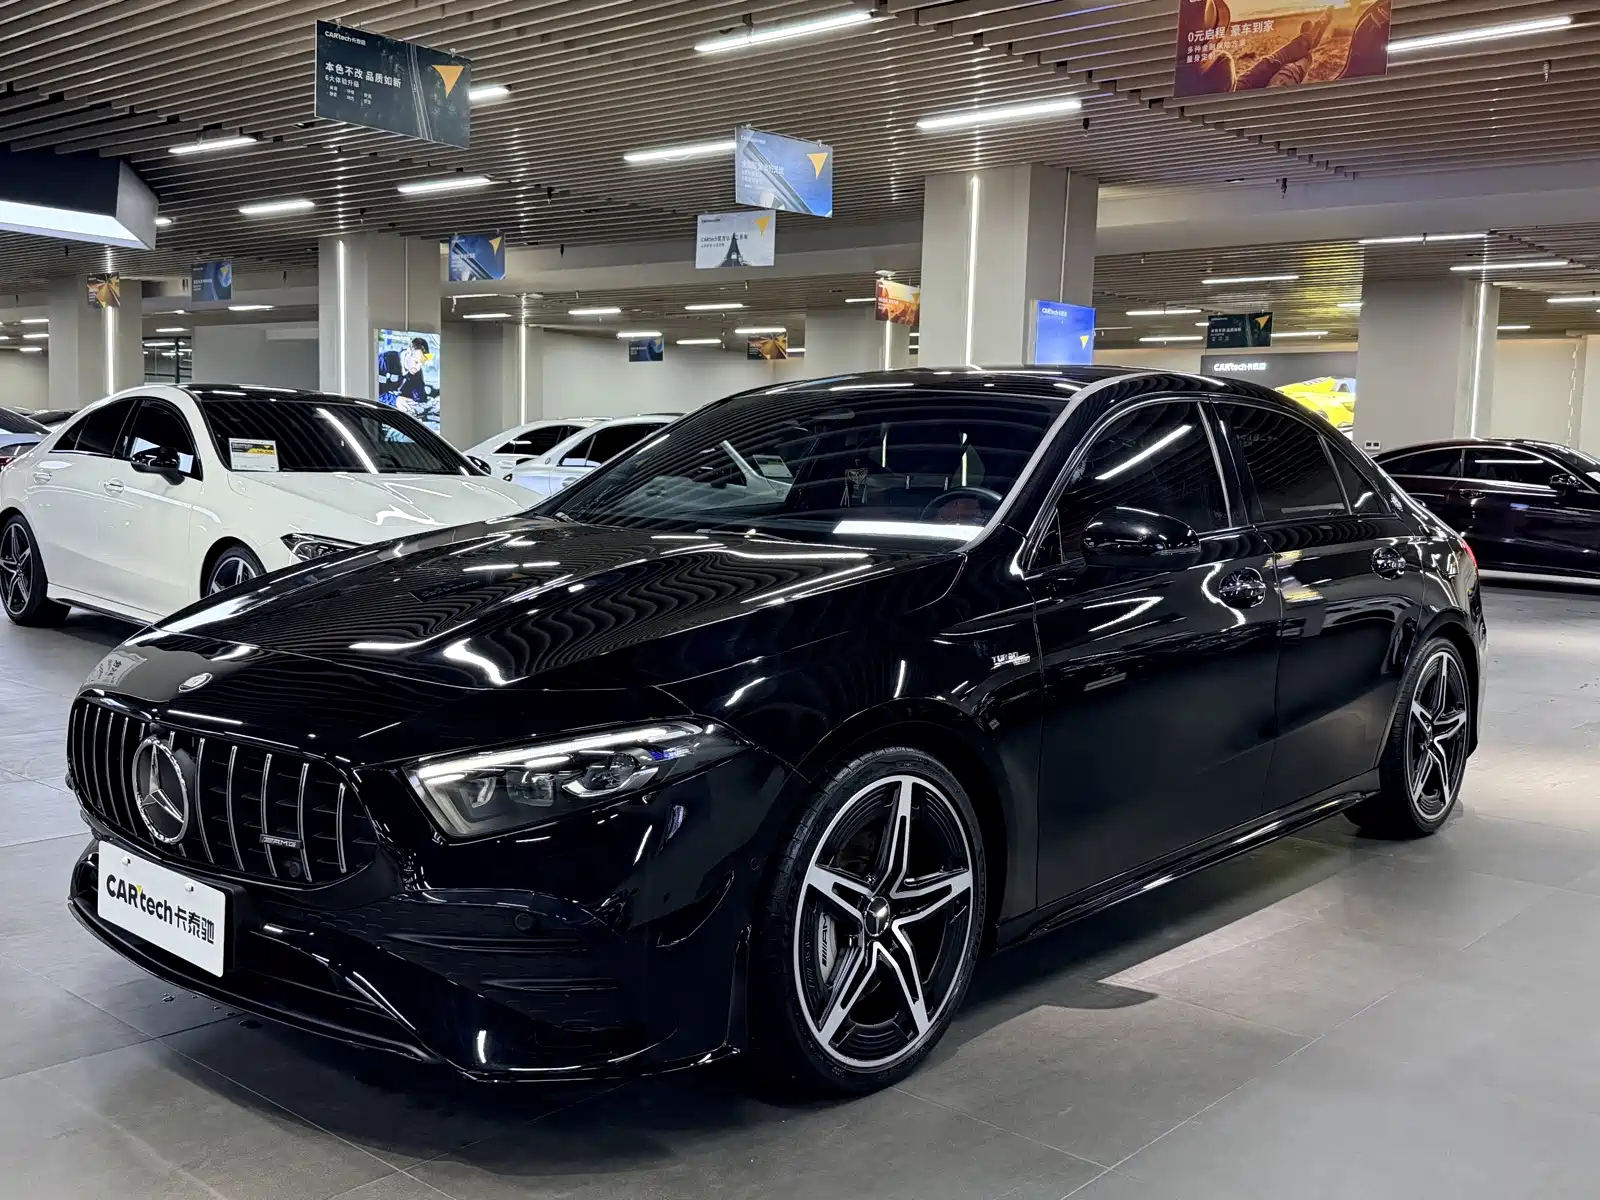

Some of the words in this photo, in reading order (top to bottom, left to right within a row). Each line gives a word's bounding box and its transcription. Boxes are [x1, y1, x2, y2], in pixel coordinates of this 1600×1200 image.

[1187, 26, 1226, 43] 0元启程
[325, 61, 364, 80] 本色不改
[365, 71, 402, 89] 品质如新
